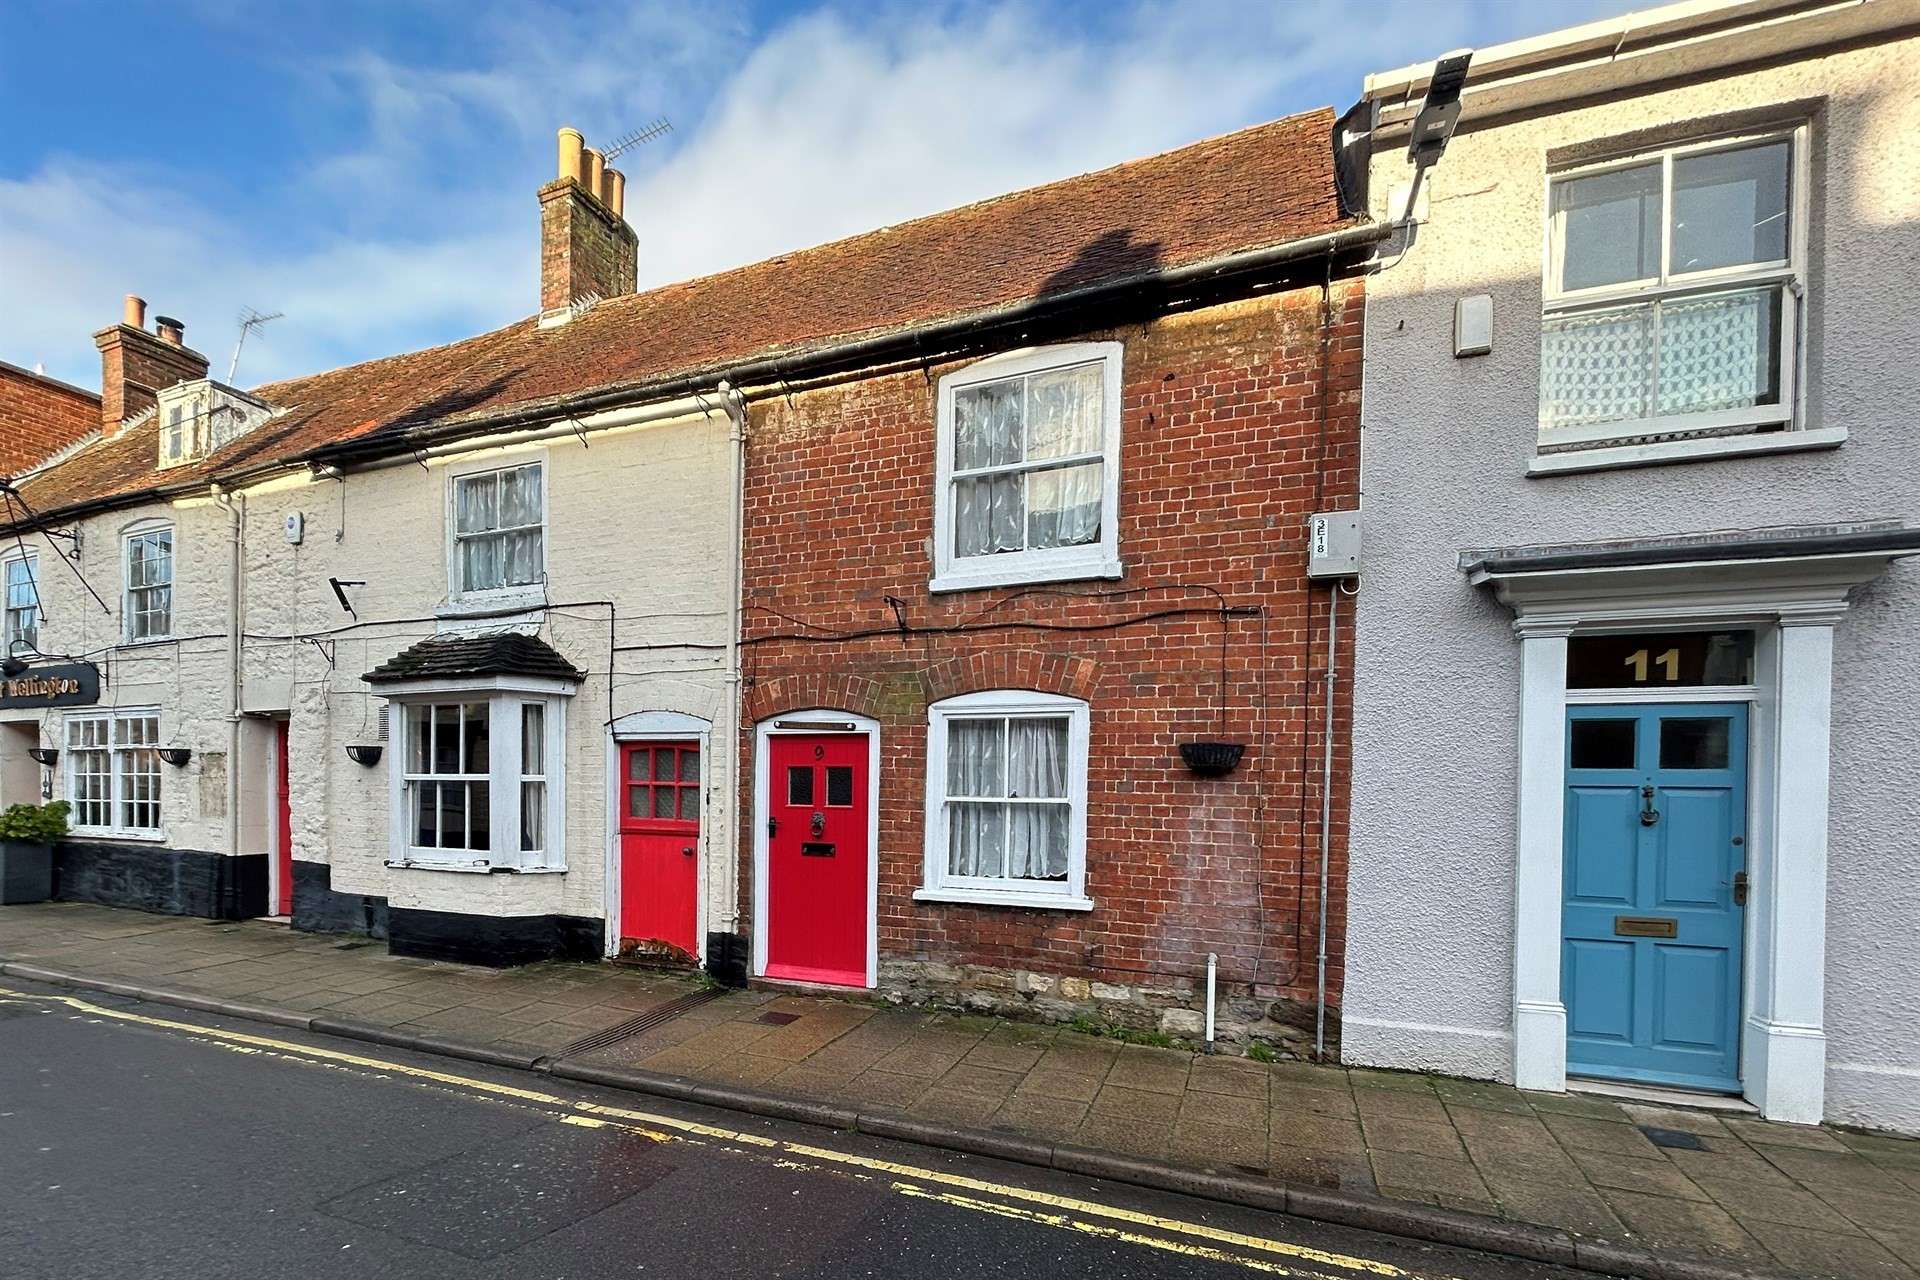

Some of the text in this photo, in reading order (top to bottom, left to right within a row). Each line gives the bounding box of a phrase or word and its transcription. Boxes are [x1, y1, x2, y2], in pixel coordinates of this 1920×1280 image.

[1317, 519, 1325, 553] 3E18
[1624, 649, 1679, 681] 11
[8, 675, 79, 699] Wellington
[815, 745, 825, 761] 9
